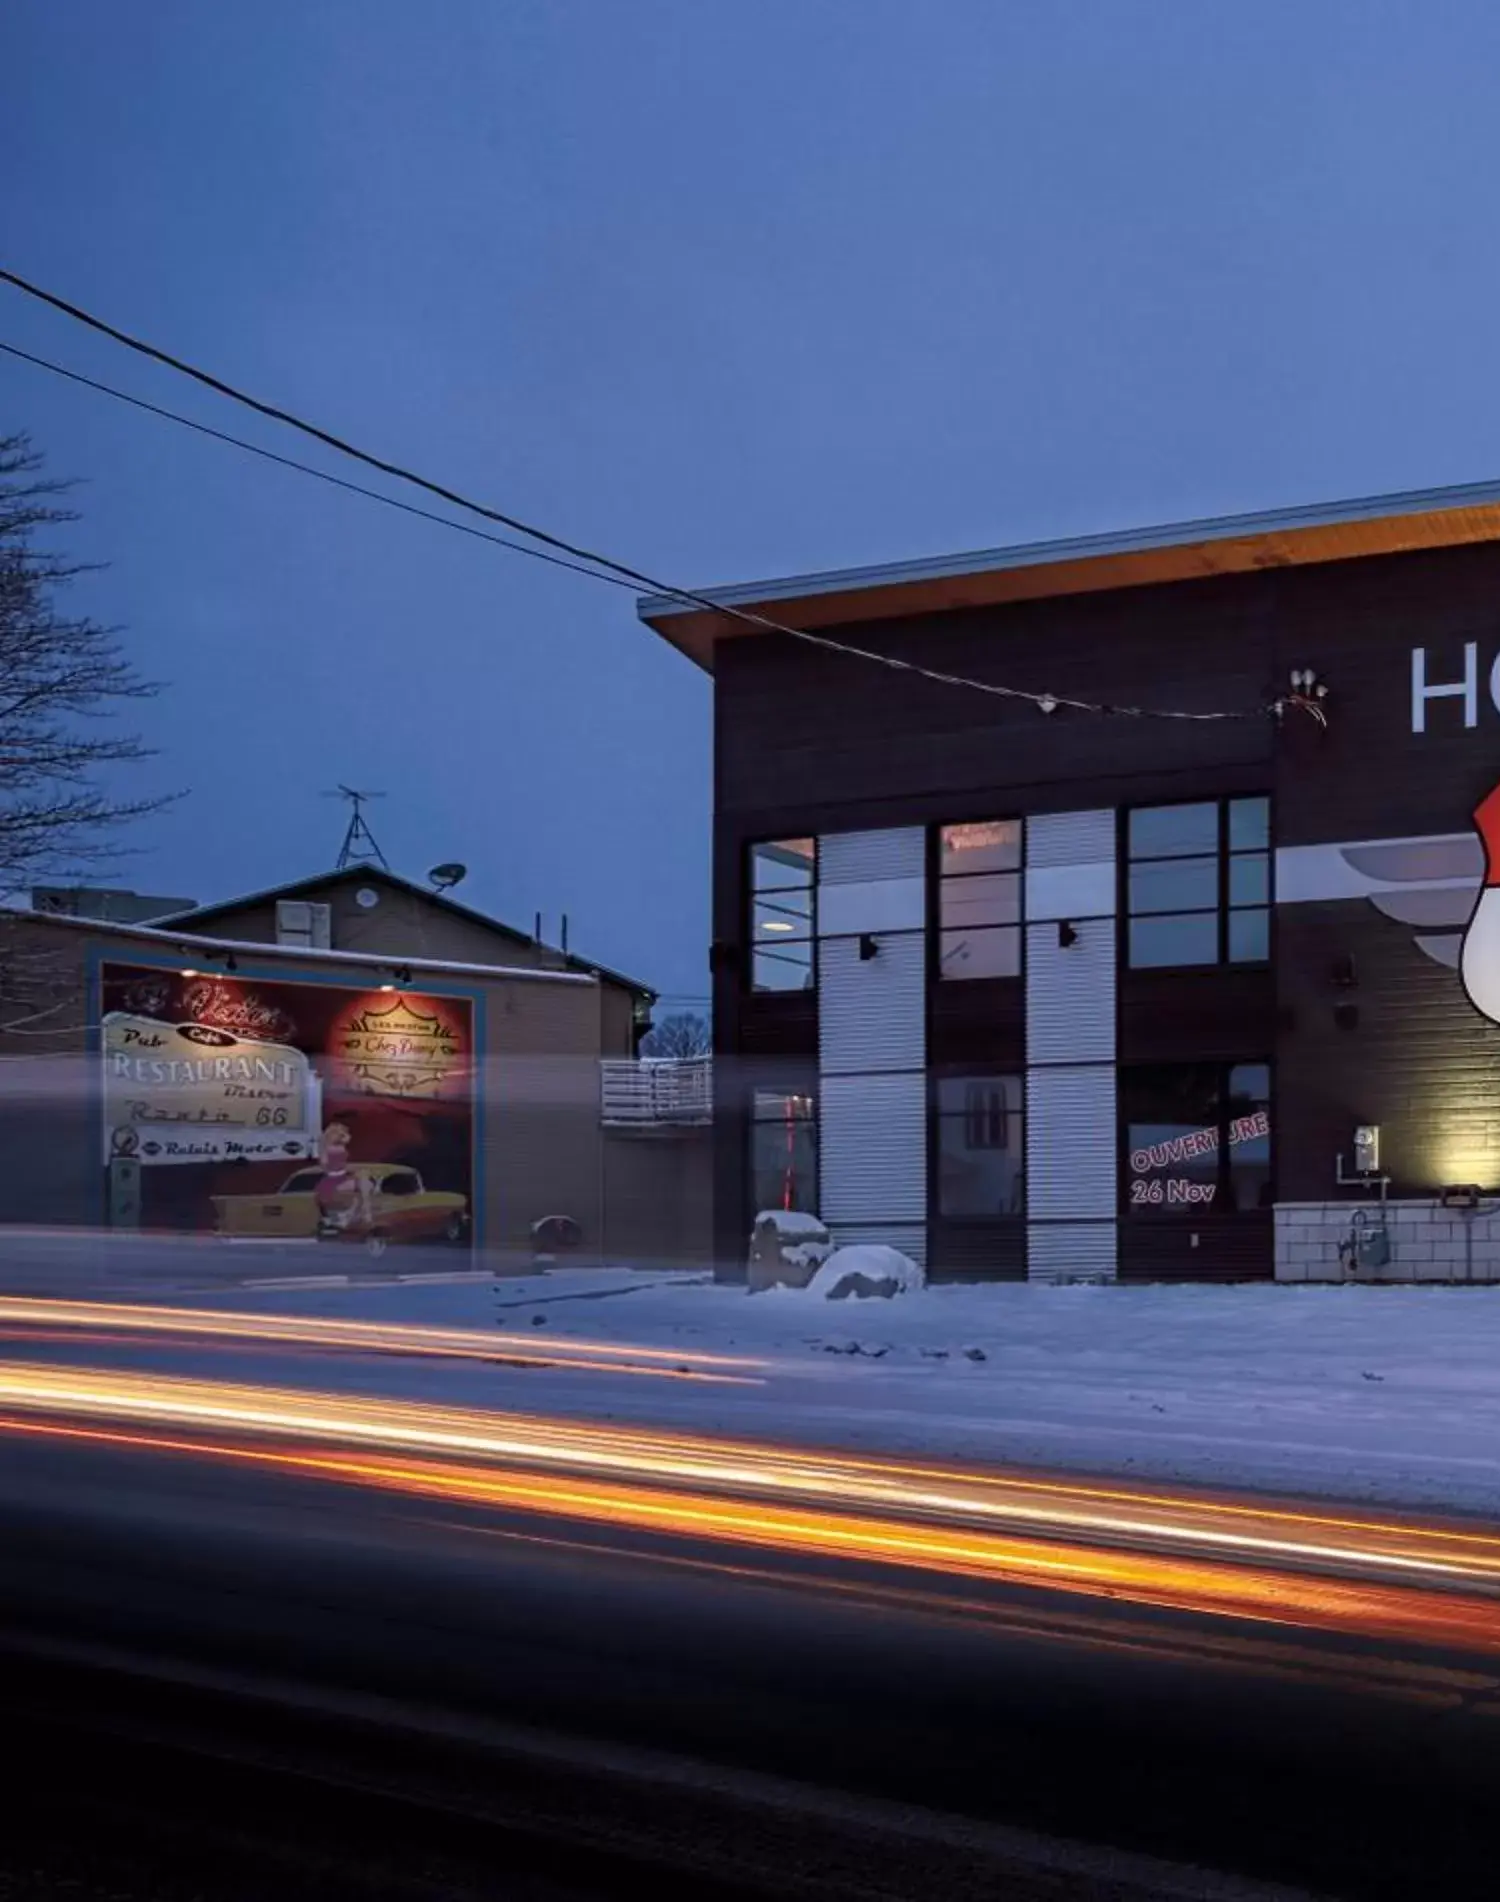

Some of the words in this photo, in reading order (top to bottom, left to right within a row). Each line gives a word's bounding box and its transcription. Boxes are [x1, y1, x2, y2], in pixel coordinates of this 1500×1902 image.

[123, 1028, 169, 1047] Pub
[113, 1053, 299, 1086] RESTAURANT
[255, 1106, 290, 1126] 66
[1130, 1111, 1270, 1173] OUVERTURE
[1130, 1180, 1164, 1203] 26
[1167, 1179, 1216, 1202] Nov
